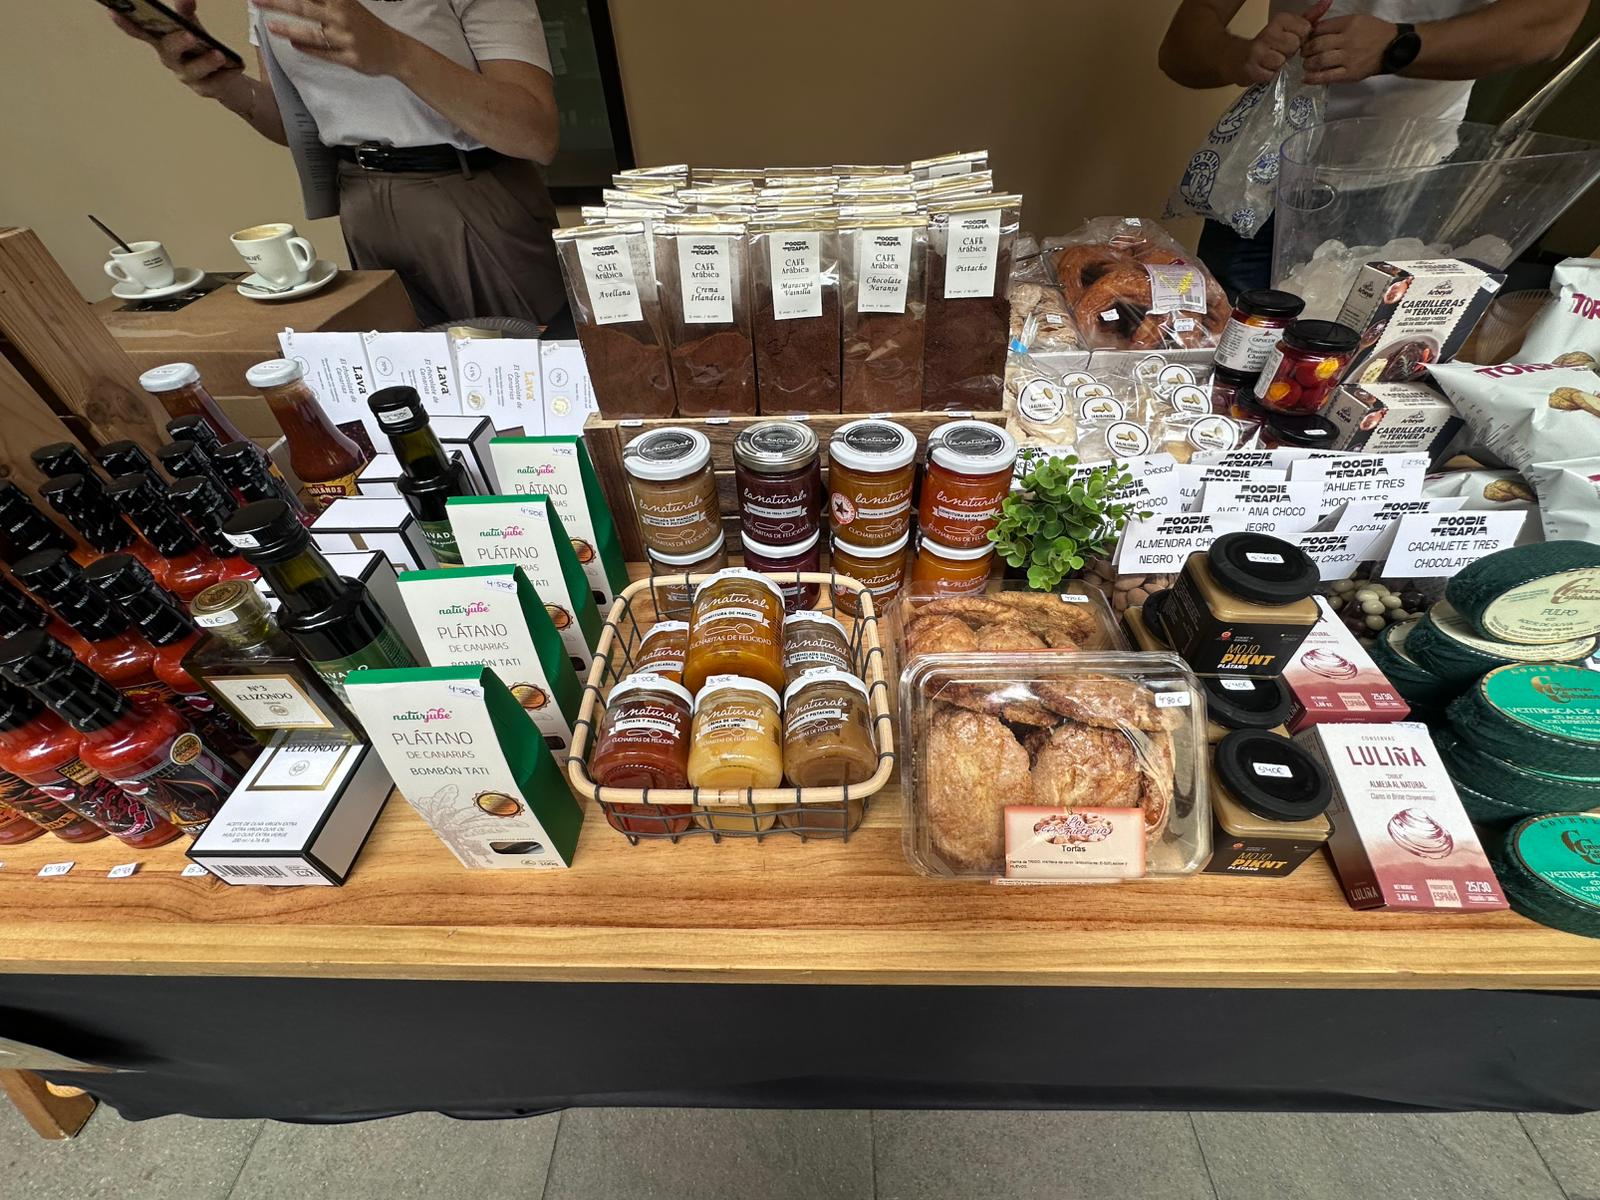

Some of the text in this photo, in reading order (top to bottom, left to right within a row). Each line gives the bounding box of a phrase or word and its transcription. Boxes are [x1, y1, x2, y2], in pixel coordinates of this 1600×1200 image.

[955, 264, 988, 272] Pistacho
[781, 281, 813, 290] Maracuyá
[866, 276, 902, 285] Chocolate
[695, 286, 719, 294] Crema
[783, 288, 811, 297] Vainilla
[868, 283, 899, 293] Naranja
[598, 289, 631, 300] Avellana
[691, 293, 725, 302] Irlandesa
[1401, 298, 1466, 309] CARRILLERAS
[1412, 307, 1454, 316] TERNERA
[341, 367, 354, 394] chocolate
[352, 365, 367, 395] Lava
[425, 367, 437, 394] chocolate
[437, 364, 451, 396] Lava
[512, 373, 522, 399] chocolate
[523, 370, 536, 402] Lava
[1376, 426, 1438, 435] CARRILLERAS
[1386, 433, 1426, 441] TERNERA
[1225, 452, 1273, 460] FOODIE
[1218, 459, 1273, 467] TERAPIA
[1331, 457, 1384, 469] FOODIE
[517, 464, 555, 477] naturjube
[1205, 468, 1250, 478] FOODIE
[1325, 467, 1389, 479] TERAPIA
[514, 481, 568, 496] PLÁTANO
[1240, 484, 1287, 493] FOODIE
[1376, 478, 1405, 489] TRES
[1136, 496, 1168, 509] CHOCO
[1234, 494, 1291, 503] TERAPIA
[1272, 506, 1306, 516] CHOCO
[1381, 501, 1431, 512] FOODIE
[1163, 515, 1211, 525] FOODIE
[1438, 515, 1488, 526] FOODIE
[479, 525, 523, 540] naturjube
[1156, 524, 1214, 536] TERAPIA
[1430, 526, 1488, 538] TERAPIA
[1135, 537, 1193, 549] ALMENDRA
[1300, 535, 1350, 545] FOODIE
[1407, 539, 1500, 552] CACAHUETE TRES
[477, 545, 539, 561] PLÁTANO
[1321, 553, 1356, 564] CHOCO
[1138, 554, 1185, 564] NEGRO Y
[486, 579, 515, 591] 4'50€
[712, 592, 766, 609] natural
[439, 601, 488, 616] naturjube
[437, 622, 509, 640] PLÁTANO
[448, 641, 509, 653] DE CANARIAS
[689, 635, 726, 650] CUCHARITAS
[738, 634, 772, 646] FELICIDAD
[1226, 644, 1261, 655] MOJO
[497, 658, 521, 668] TATI
[1220, 653, 1276, 666] PIKNT
[1216, 662, 1248, 670] PLÁTANO
[236, 692, 293, 701] ELIZONDO
[393, 707, 450, 723] naturjube
[629, 705, 679, 722] natural
[711, 705, 761, 720] natural
[391, 729, 474, 746] PLÁTANO
[406, 750, 476, 760] DE CANARIAS
[1345, 745, 1427, 767] LULIÑA
[409, 765, 490, 776] BOMBÓN TATI
[1369, 780, 1392, 788] ALMEJA
[1400, 781, 1428, 789] NATURAL
[1061, 844, 1087, 853] Tortas
[1231, 858, 1288, 869] PIKNT
[1465, 881, 1492, 893] 25/30
